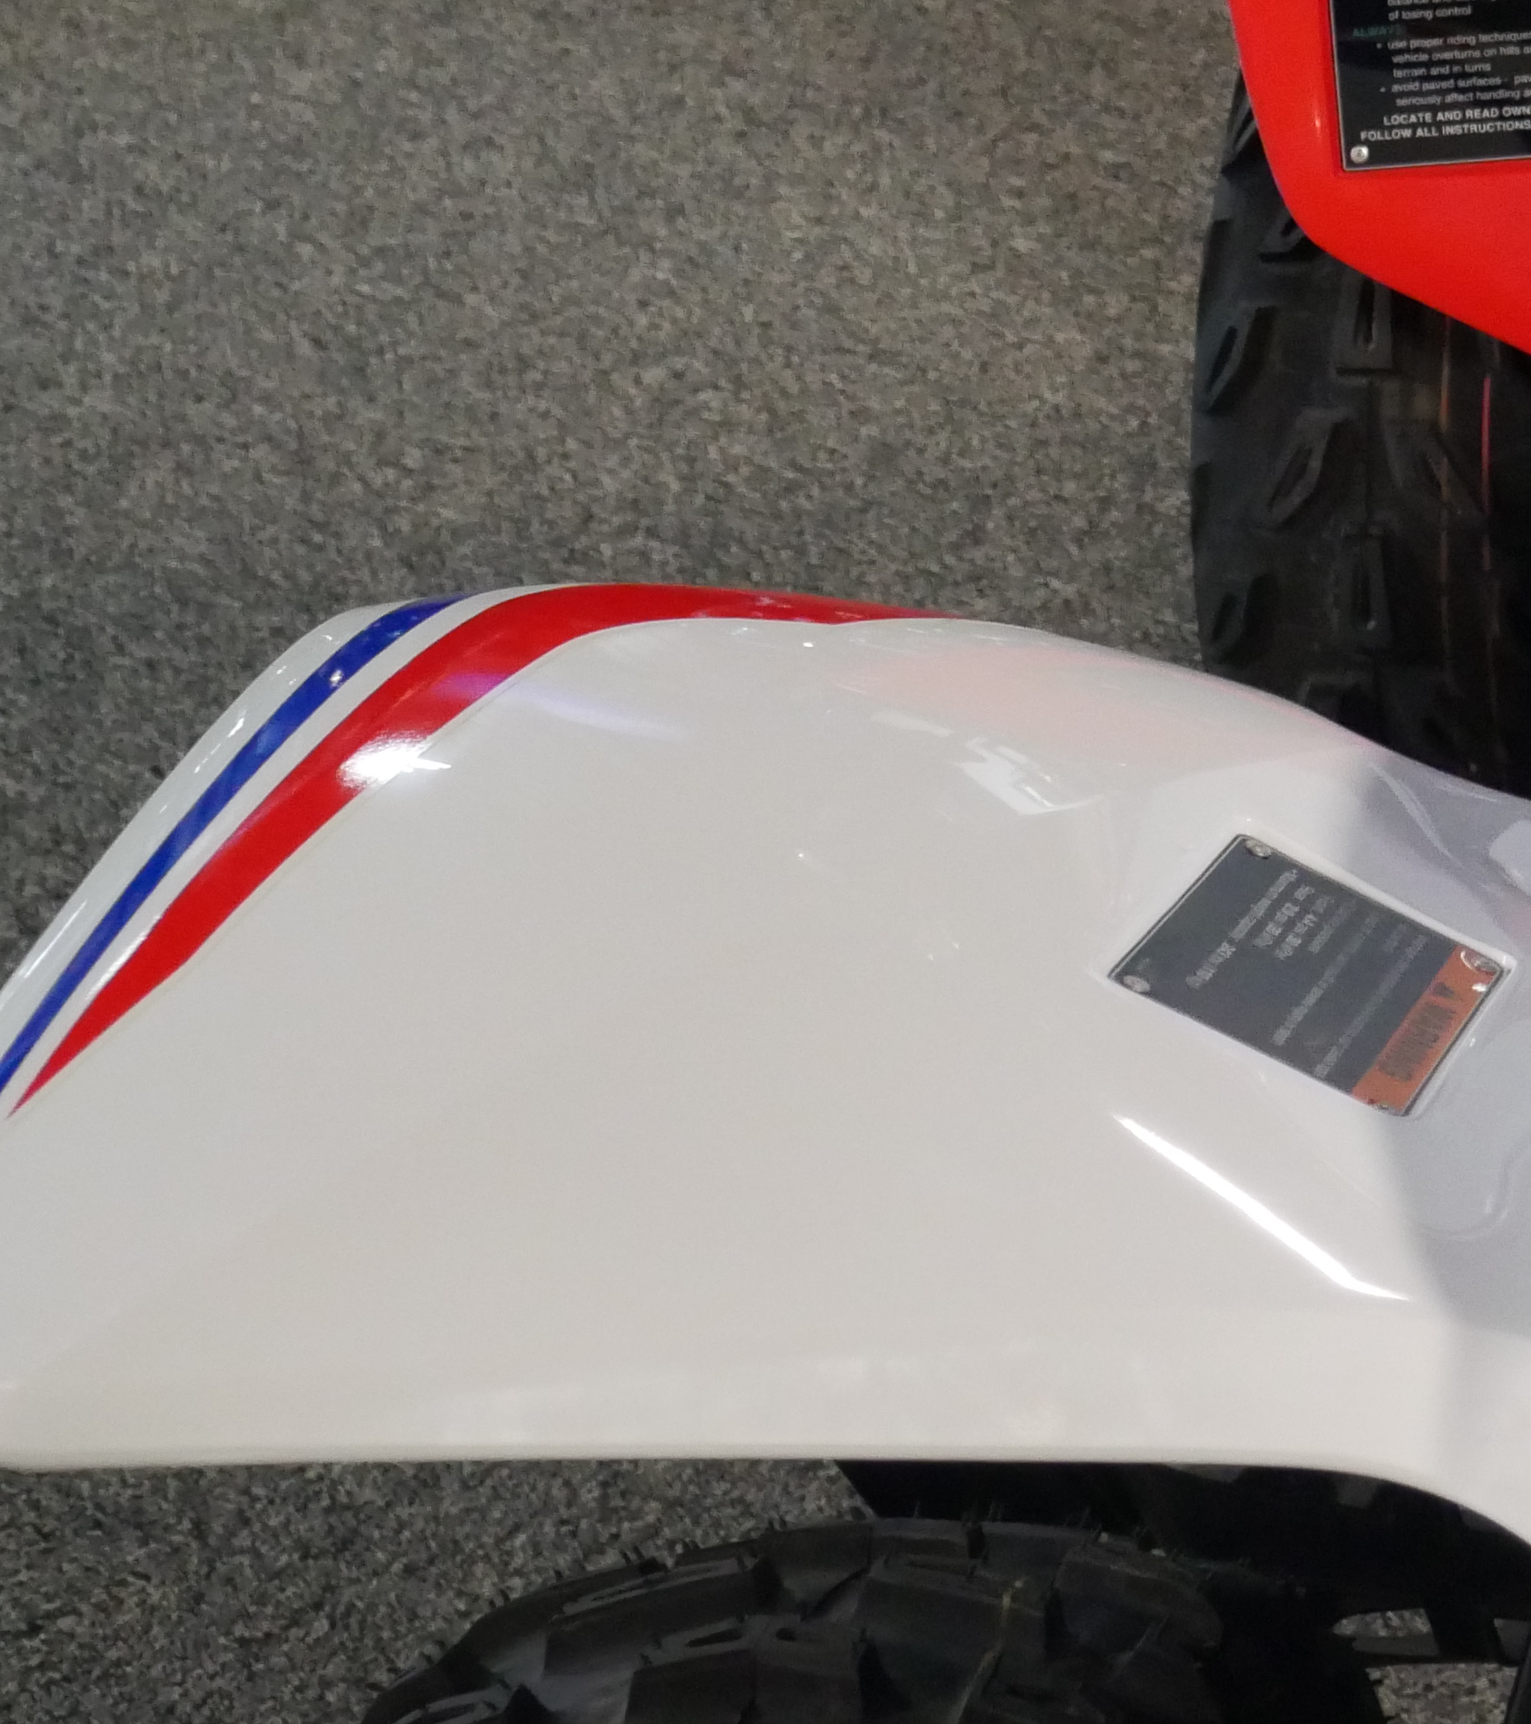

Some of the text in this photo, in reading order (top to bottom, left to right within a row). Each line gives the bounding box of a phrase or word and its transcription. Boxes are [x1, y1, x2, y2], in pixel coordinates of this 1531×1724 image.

[1383, 112, 1432, 126] LOCATE
[1436, 111, 1461, 122] AND
[1465, 108, 1499, 120] READ
[1360, 128, 1412, 142] FOLLOW
[1415, 126, 1439, 138] ALL
[1442, 119, 1531, 136] INSTRUCTIONS
